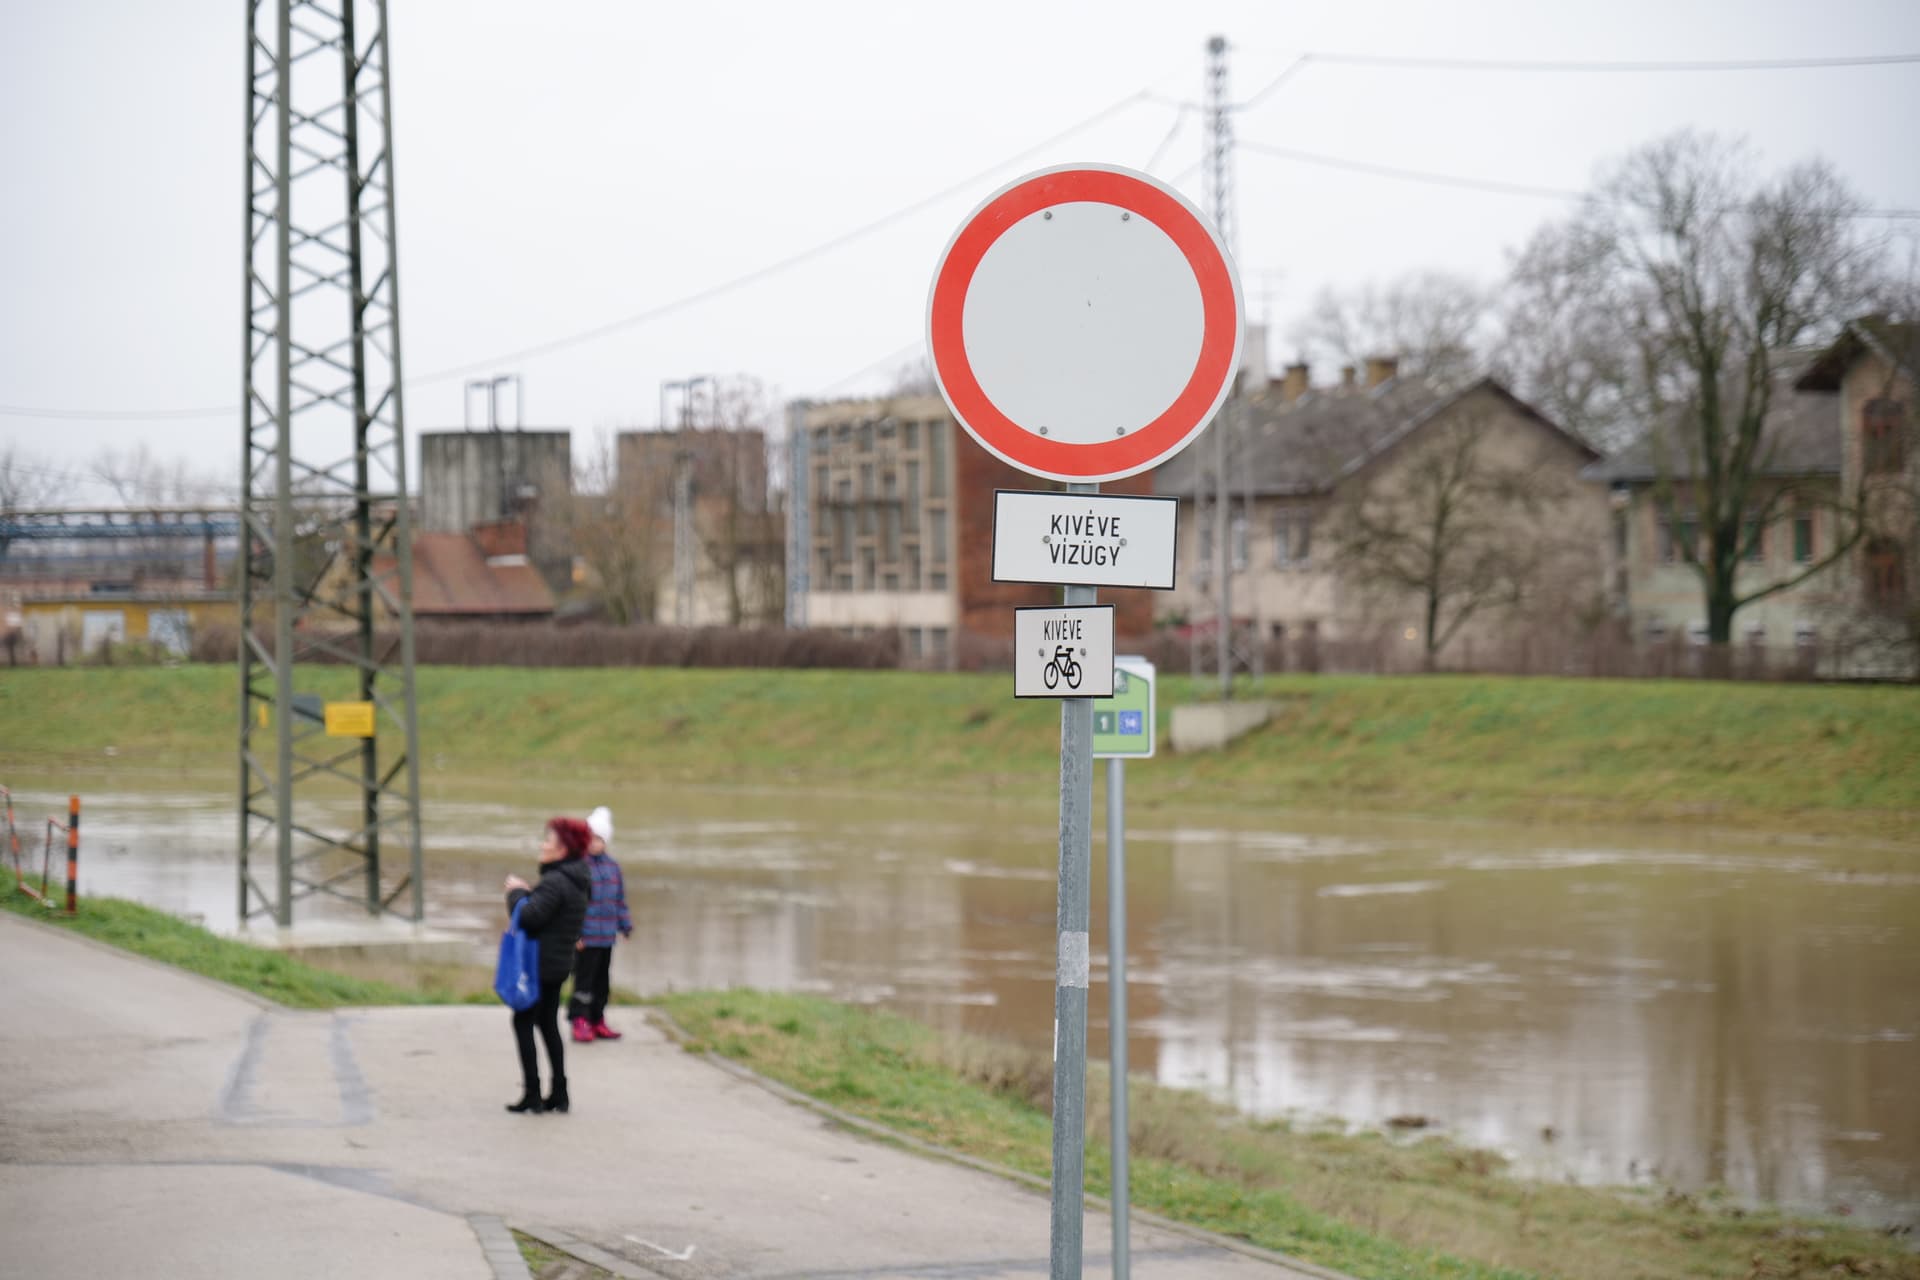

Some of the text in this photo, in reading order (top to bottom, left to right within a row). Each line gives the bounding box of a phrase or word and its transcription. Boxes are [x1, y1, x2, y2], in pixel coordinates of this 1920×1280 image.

[1051, 509, 1120, 537] KIVÉVE
[1050, 537, 1120, 566] VÍZÜGY
[1044, 613, 1082, 640] KIVÉVE
